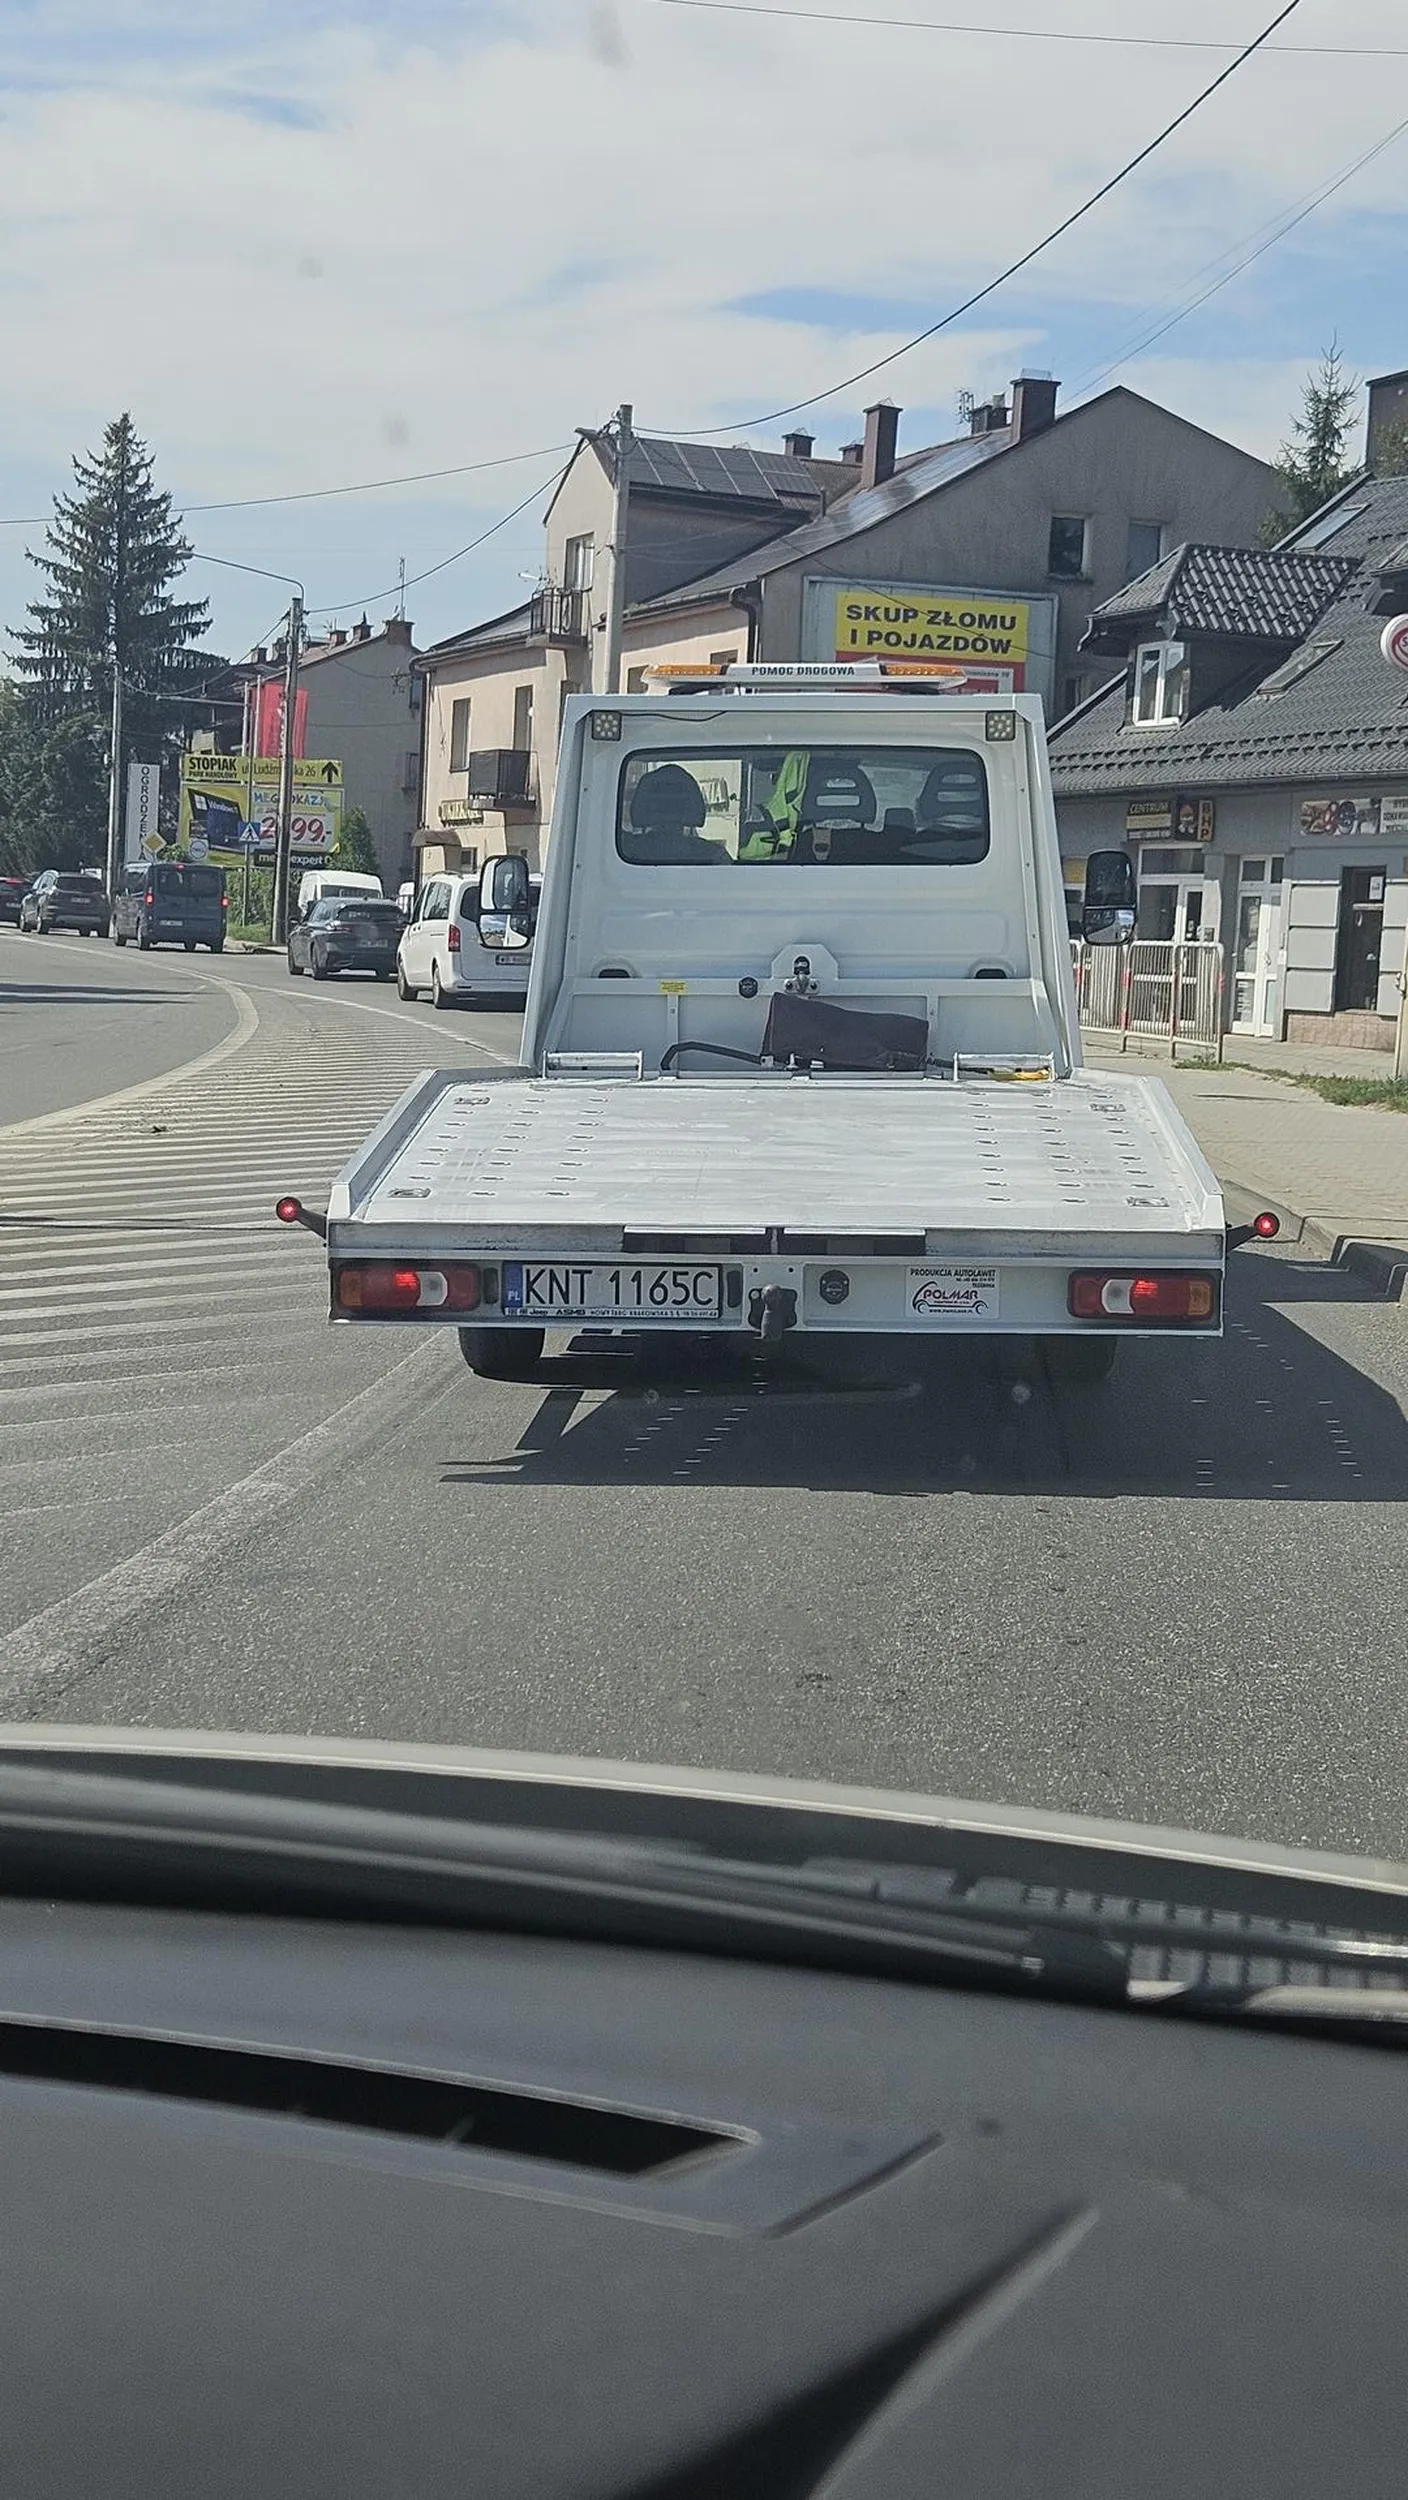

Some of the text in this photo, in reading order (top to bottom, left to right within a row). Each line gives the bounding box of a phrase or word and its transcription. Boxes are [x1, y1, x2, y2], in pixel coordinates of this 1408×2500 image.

[846, 604, 1017, 631] SKUP ZŁOMU
[850, 628, 1013, 655] I POJAZDÓW
[751, 666, 855, 676] POMOC DROGOWA
[188, 756, 237, 771] STOPIAK
[253, 762, 304, 777] Ludźmka
[260, 816, 333, 844] 299,-
[910, 1268, 952, 1277] PRODUKCJA
[508, 1291, 521, 1301] PL
[525, 1268, 714, 1306] KNT 1165C
[923, 1289, 979, 1300] POLMAR
